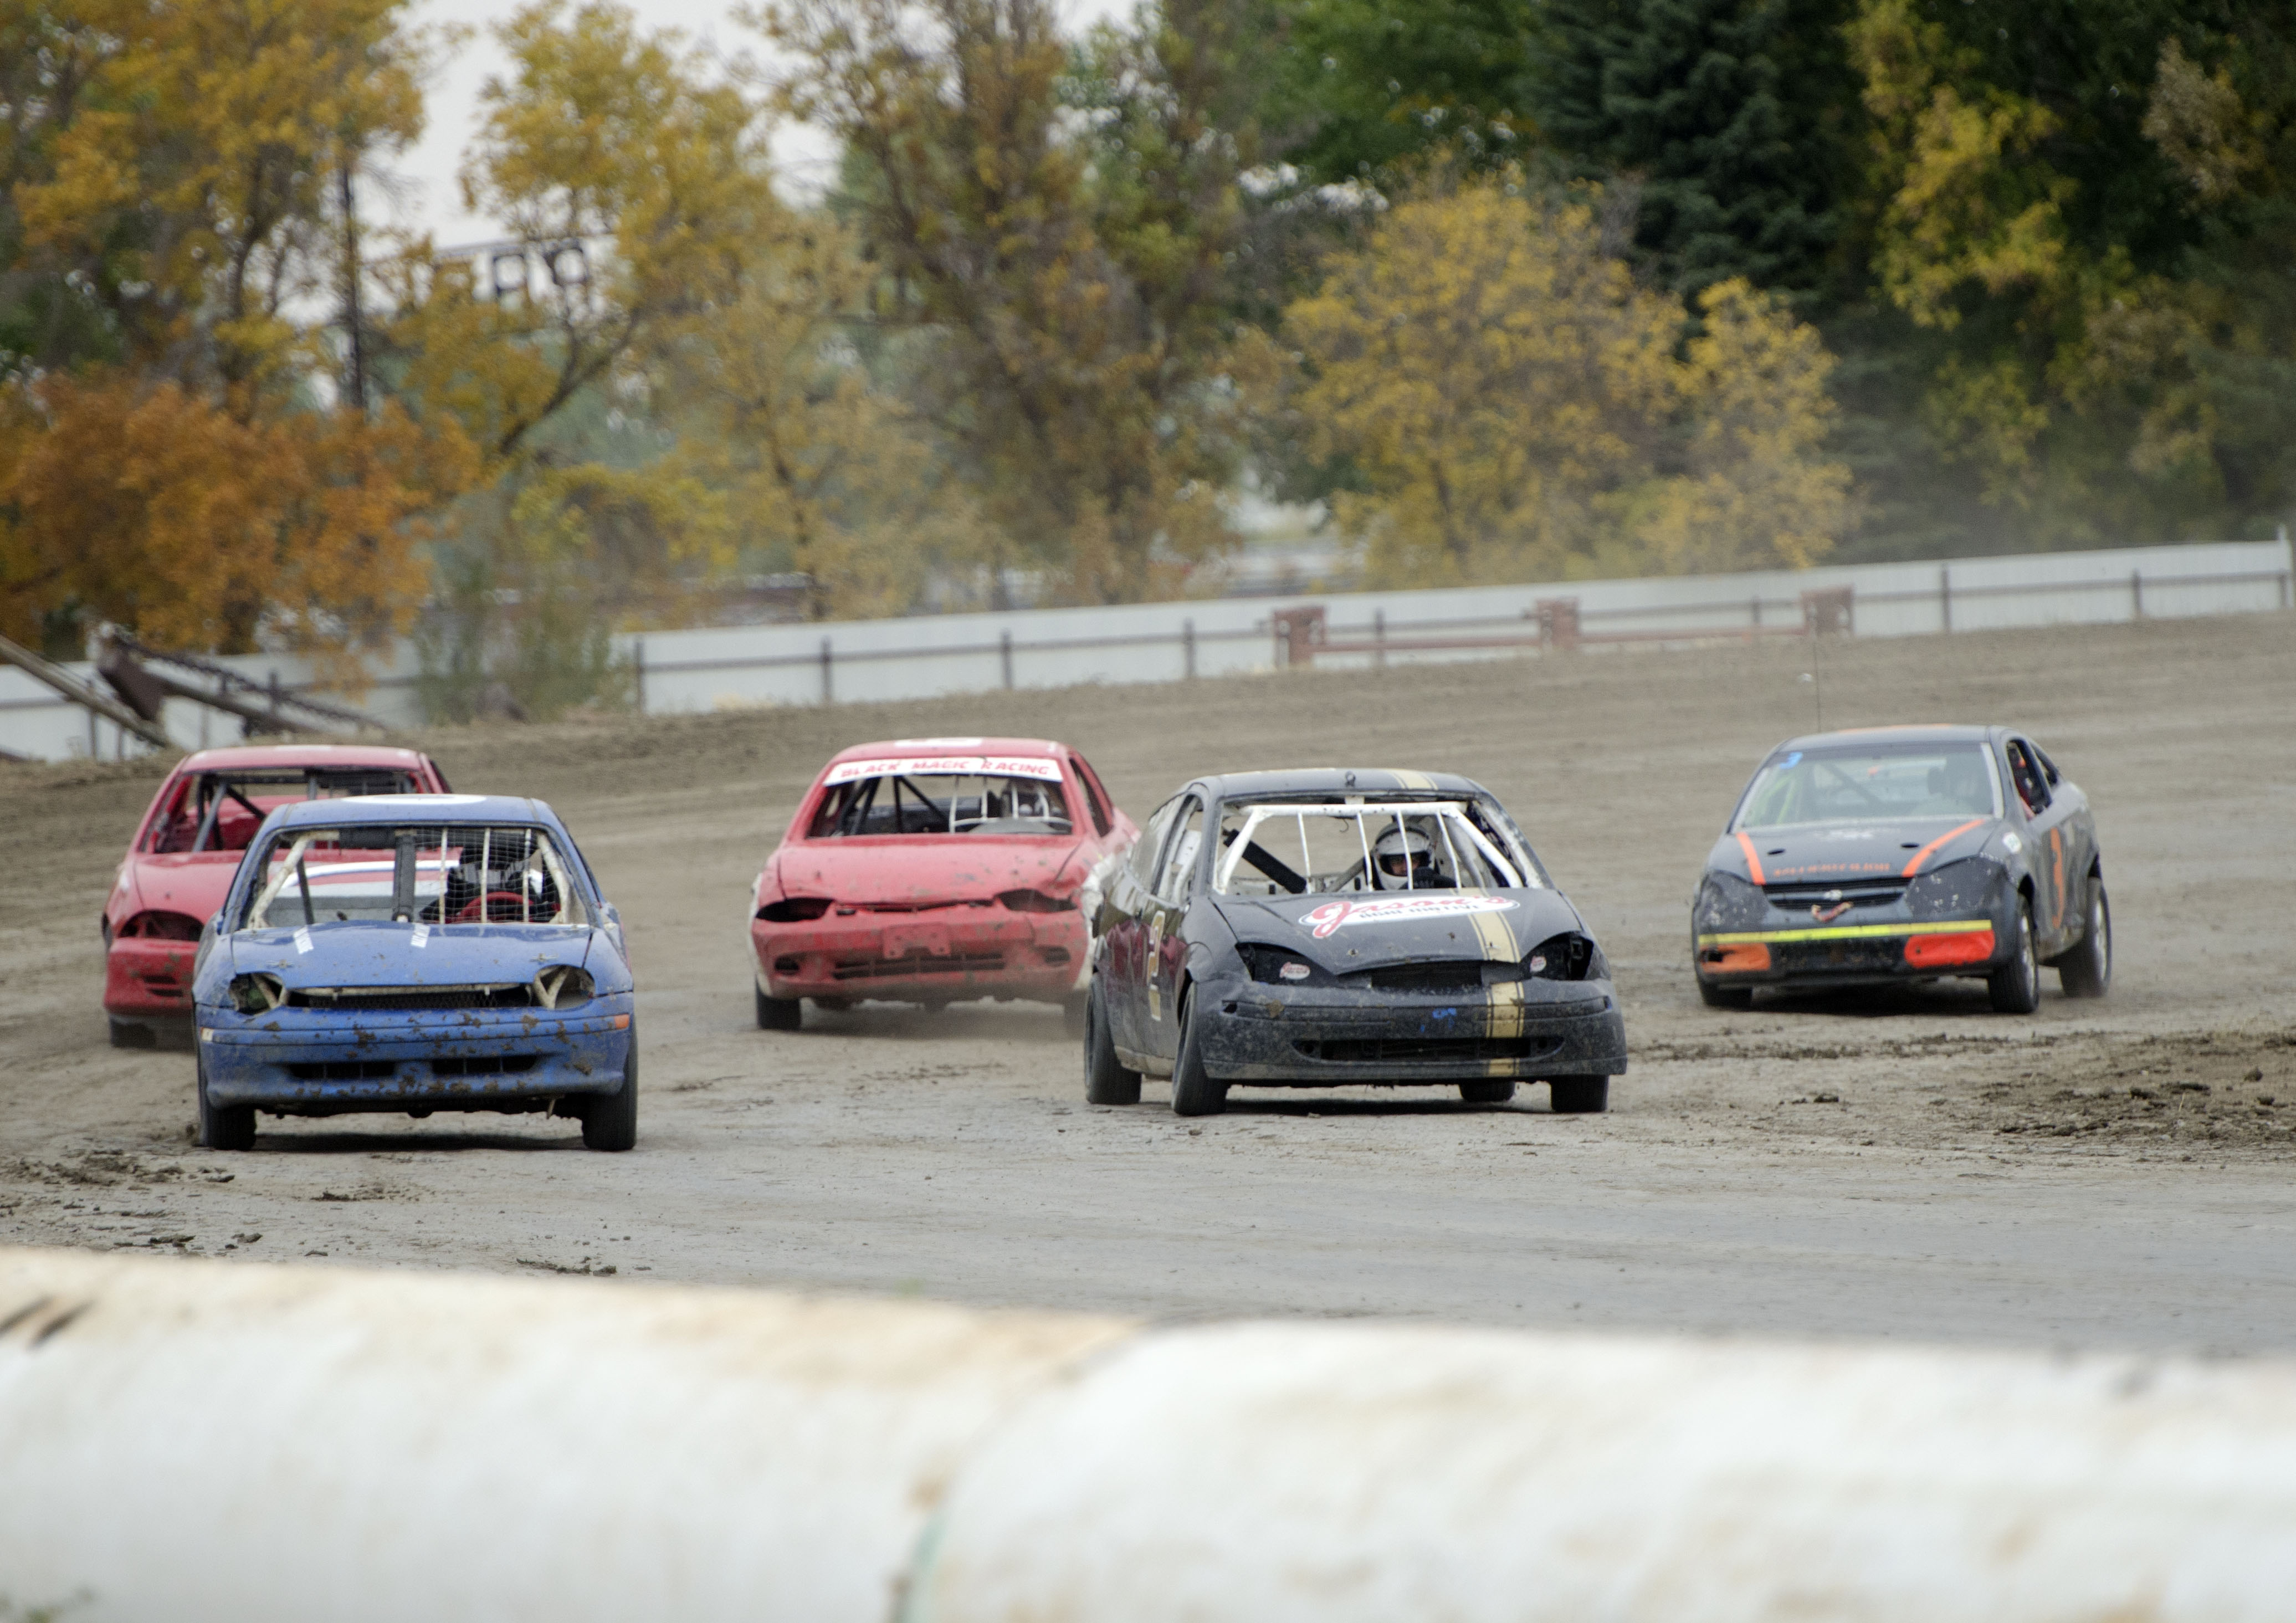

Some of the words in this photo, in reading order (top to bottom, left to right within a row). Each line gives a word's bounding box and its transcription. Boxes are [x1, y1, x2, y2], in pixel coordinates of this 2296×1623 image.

[840, 763, 901, 777] BLACK
[911, 760, 971, 770] MAGIC
[980, 760, 1050, 775] RACING
[1311, 895, 1514, 937] Jason's
